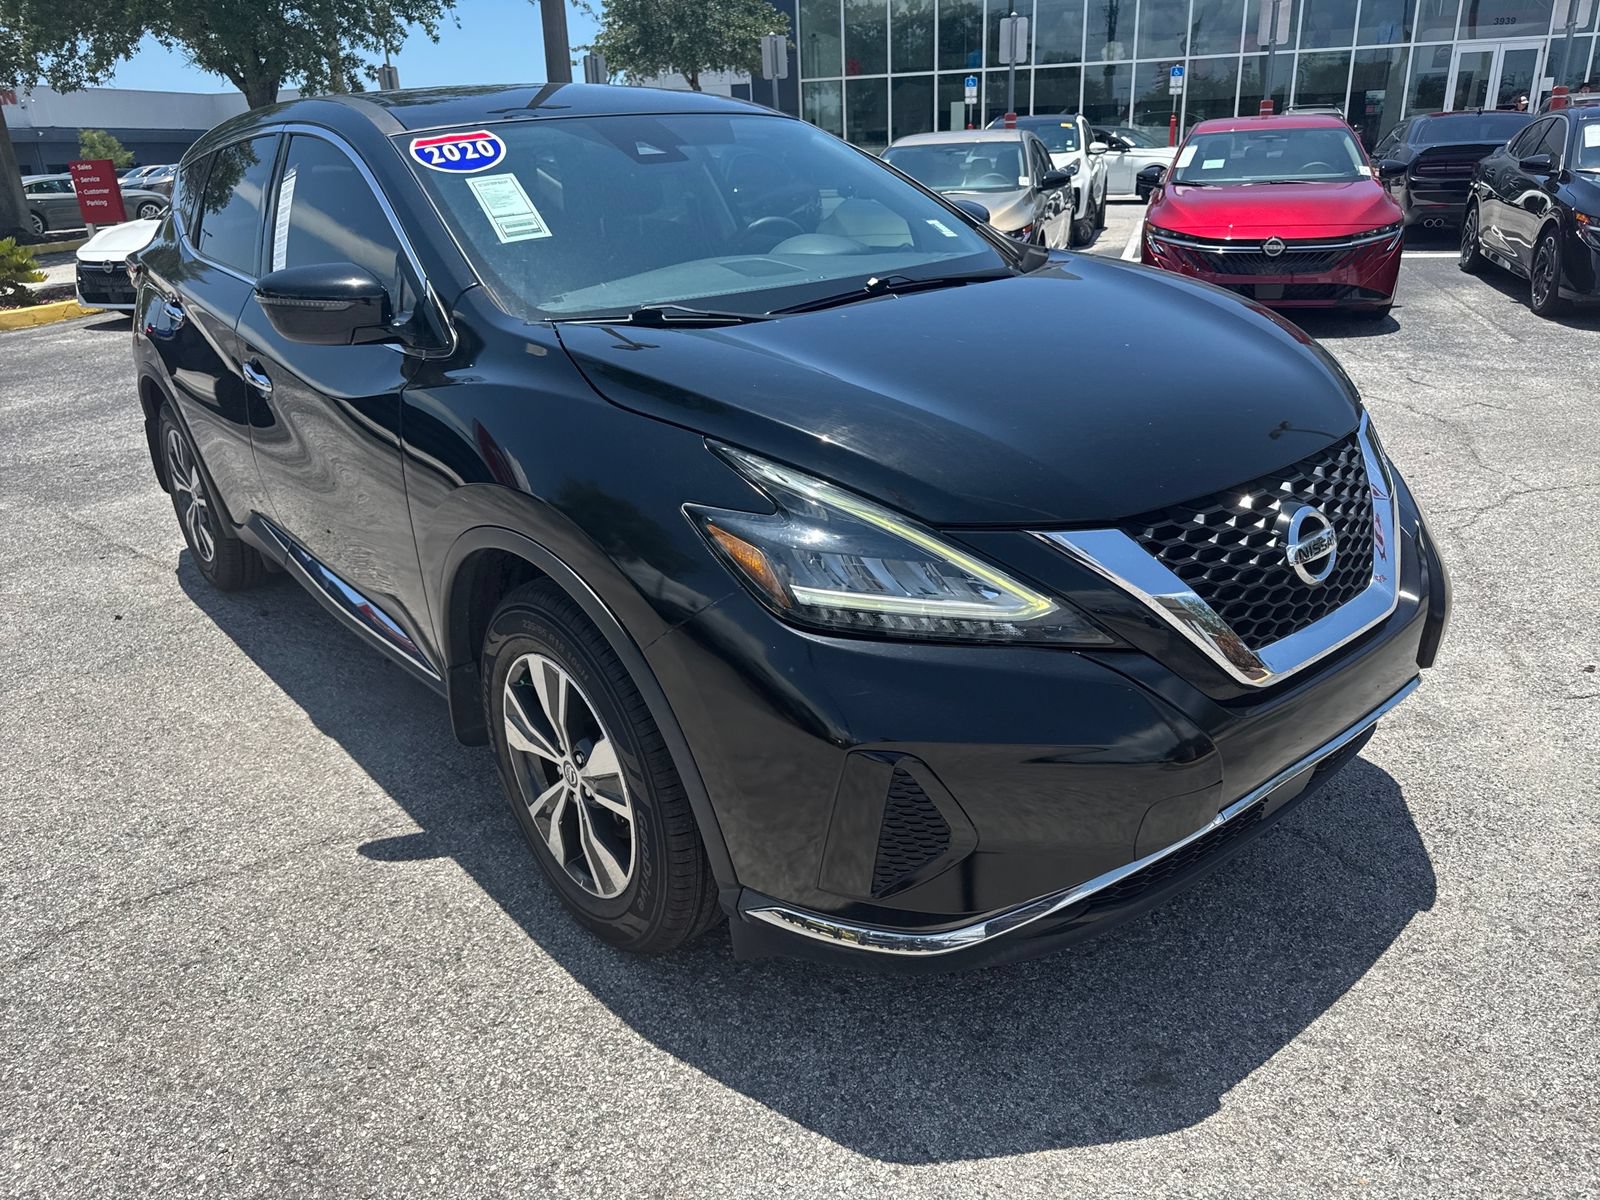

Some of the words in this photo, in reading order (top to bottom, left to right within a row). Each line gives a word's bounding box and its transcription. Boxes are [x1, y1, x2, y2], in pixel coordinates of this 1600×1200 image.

[1493, 16, 1517, 26] 3939
[424, 140, 495, 164] 2020
[636, 809, 652, 912] GeoDrive
